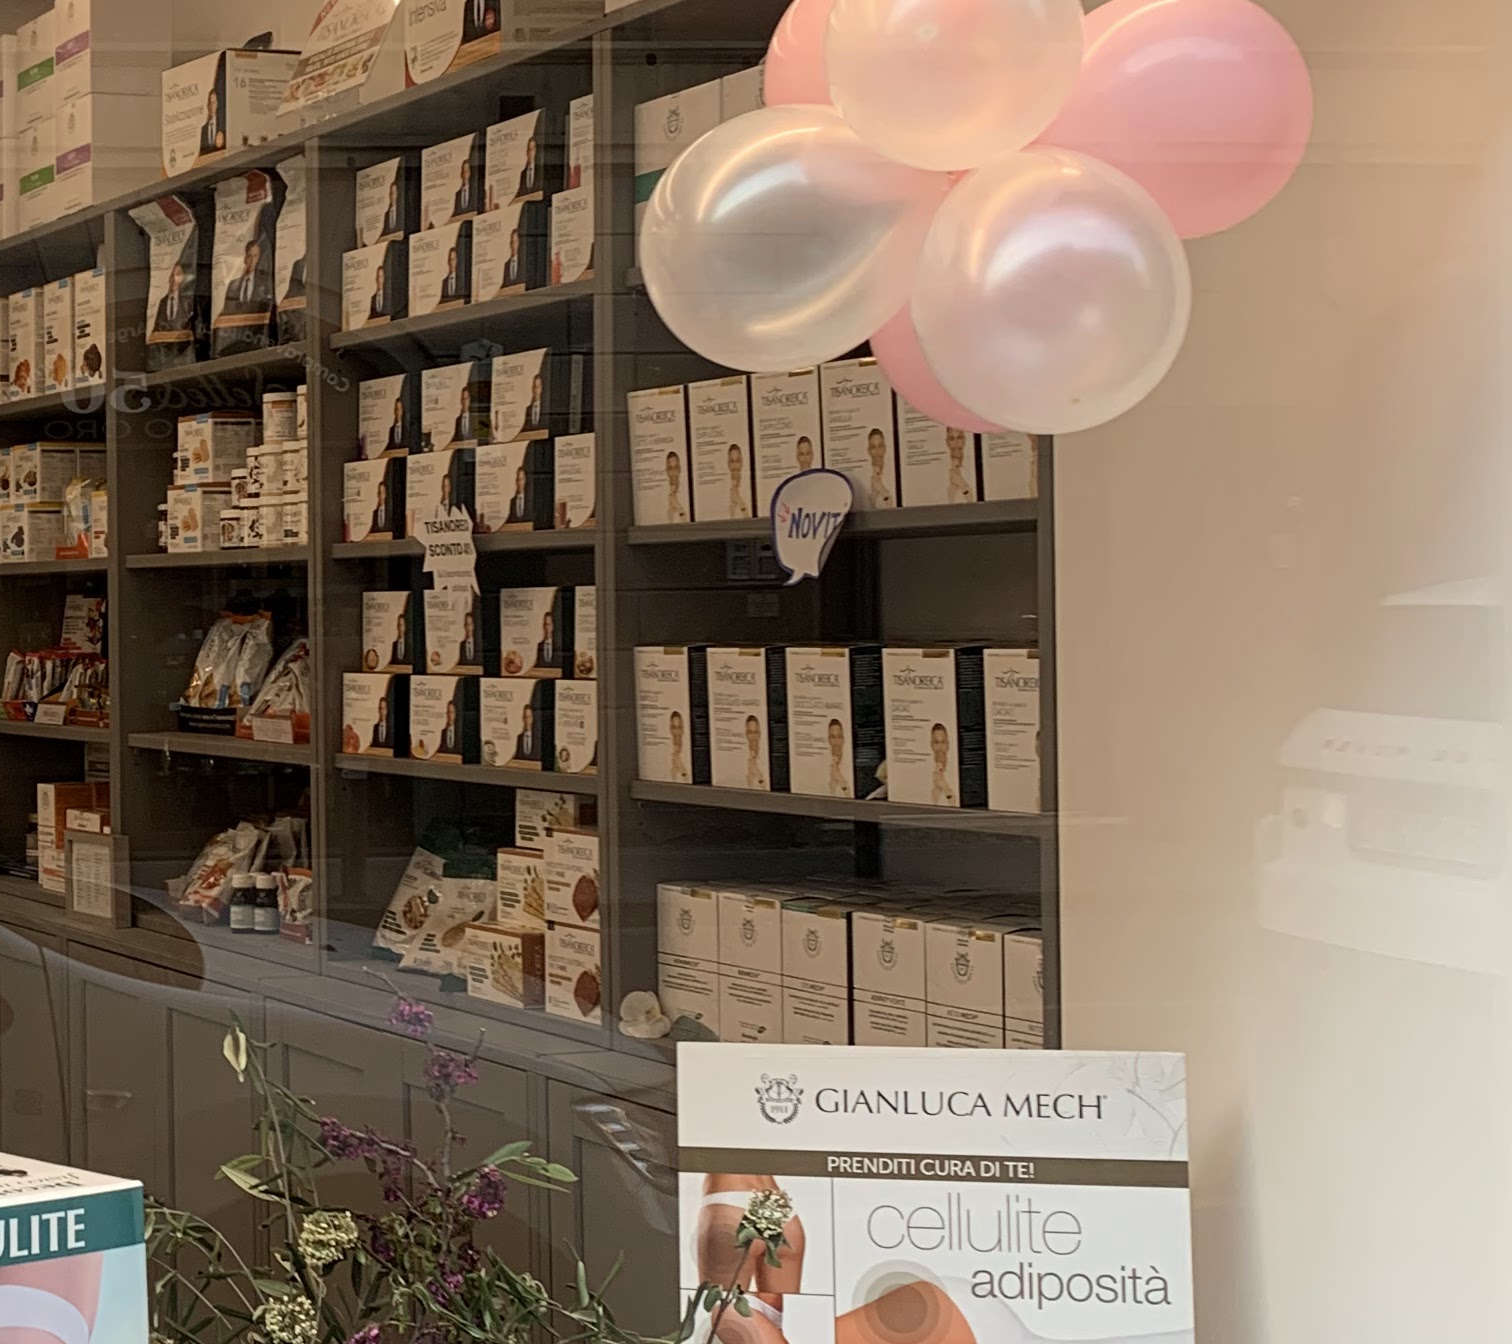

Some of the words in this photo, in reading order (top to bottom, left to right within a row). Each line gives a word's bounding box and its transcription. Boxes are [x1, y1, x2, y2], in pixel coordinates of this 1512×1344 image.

[788, 508, 841, 540] NOVIT
[815, 1087, 991, 1118] GIANLUCA
[1004, 1093, 1104, 1120] MECH
[827, 1156, 915, 1175] PRENDITI
[919, 1159, 974, 1178] CURA
[980, 1161, 1000, 1178] DI
[1004, 1162, 1035, 1179] TE!
[867, 1192, 1082, 1256] cellulite
[971, 1262, 1171, 1310] adiposità
